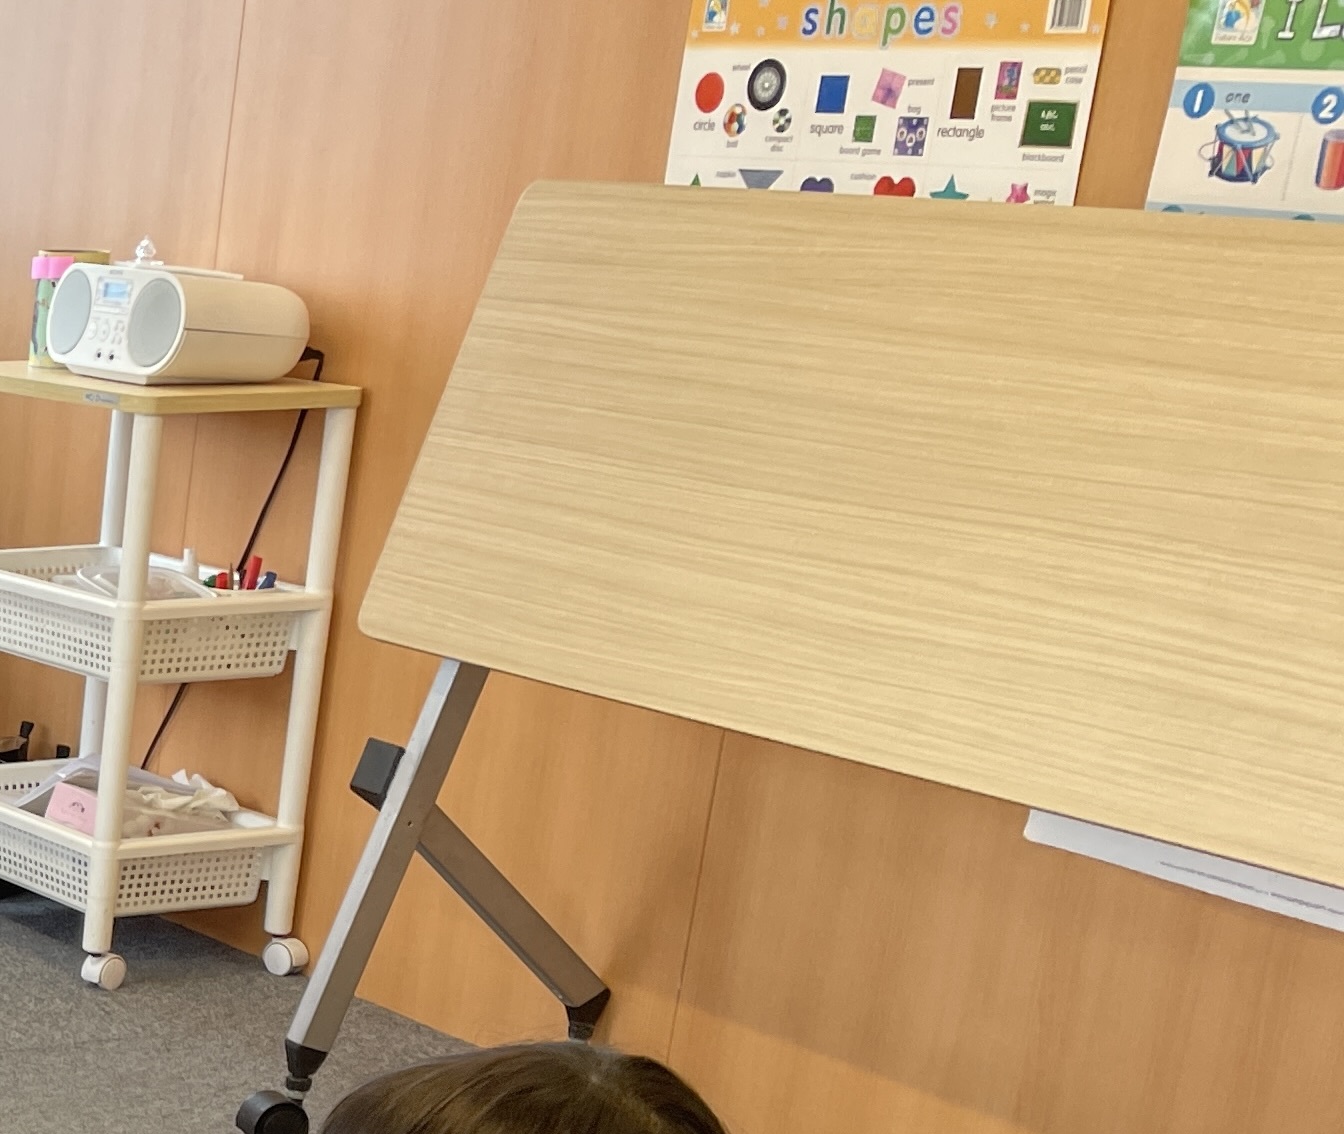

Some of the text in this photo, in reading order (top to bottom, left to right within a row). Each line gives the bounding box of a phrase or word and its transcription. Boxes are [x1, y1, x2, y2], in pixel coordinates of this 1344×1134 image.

[801, 0, 959, 46] shapes
[1311, 0, 1344, 40] L
[1193, 90, 1338, 118] 1 one 2
[693, 119, 716, 132] circle
[810, 123, 844, 137] square
[937, 125, 985, 142] rectangle
